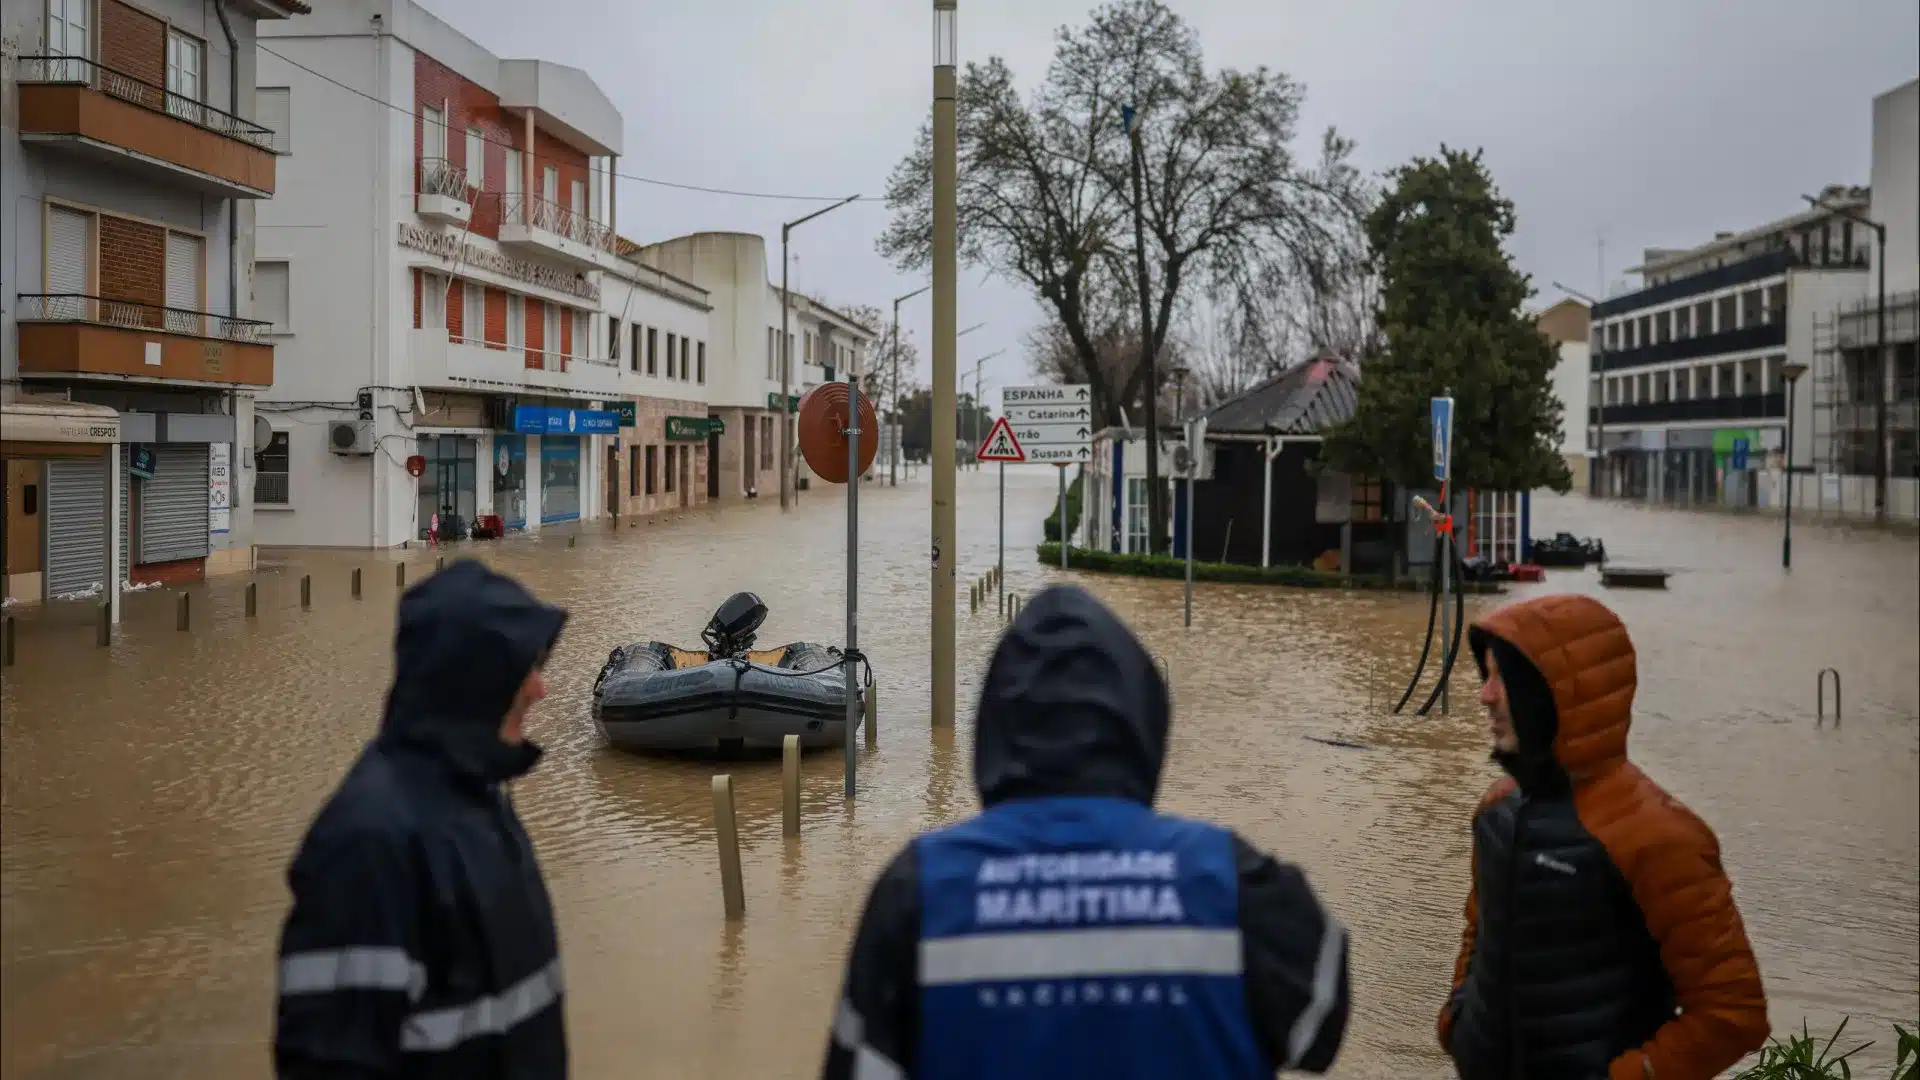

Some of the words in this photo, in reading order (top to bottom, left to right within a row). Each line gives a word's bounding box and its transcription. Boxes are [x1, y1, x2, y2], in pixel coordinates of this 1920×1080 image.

[1003, 389, 1064, 400] ESPANHA
[621, 408, 633, 417] CA
[1028, 410, 1076, 420] Catarina
[90, 427, 117, 438] CRESPO'S
[1031, 448, 1073, 459] Susana
